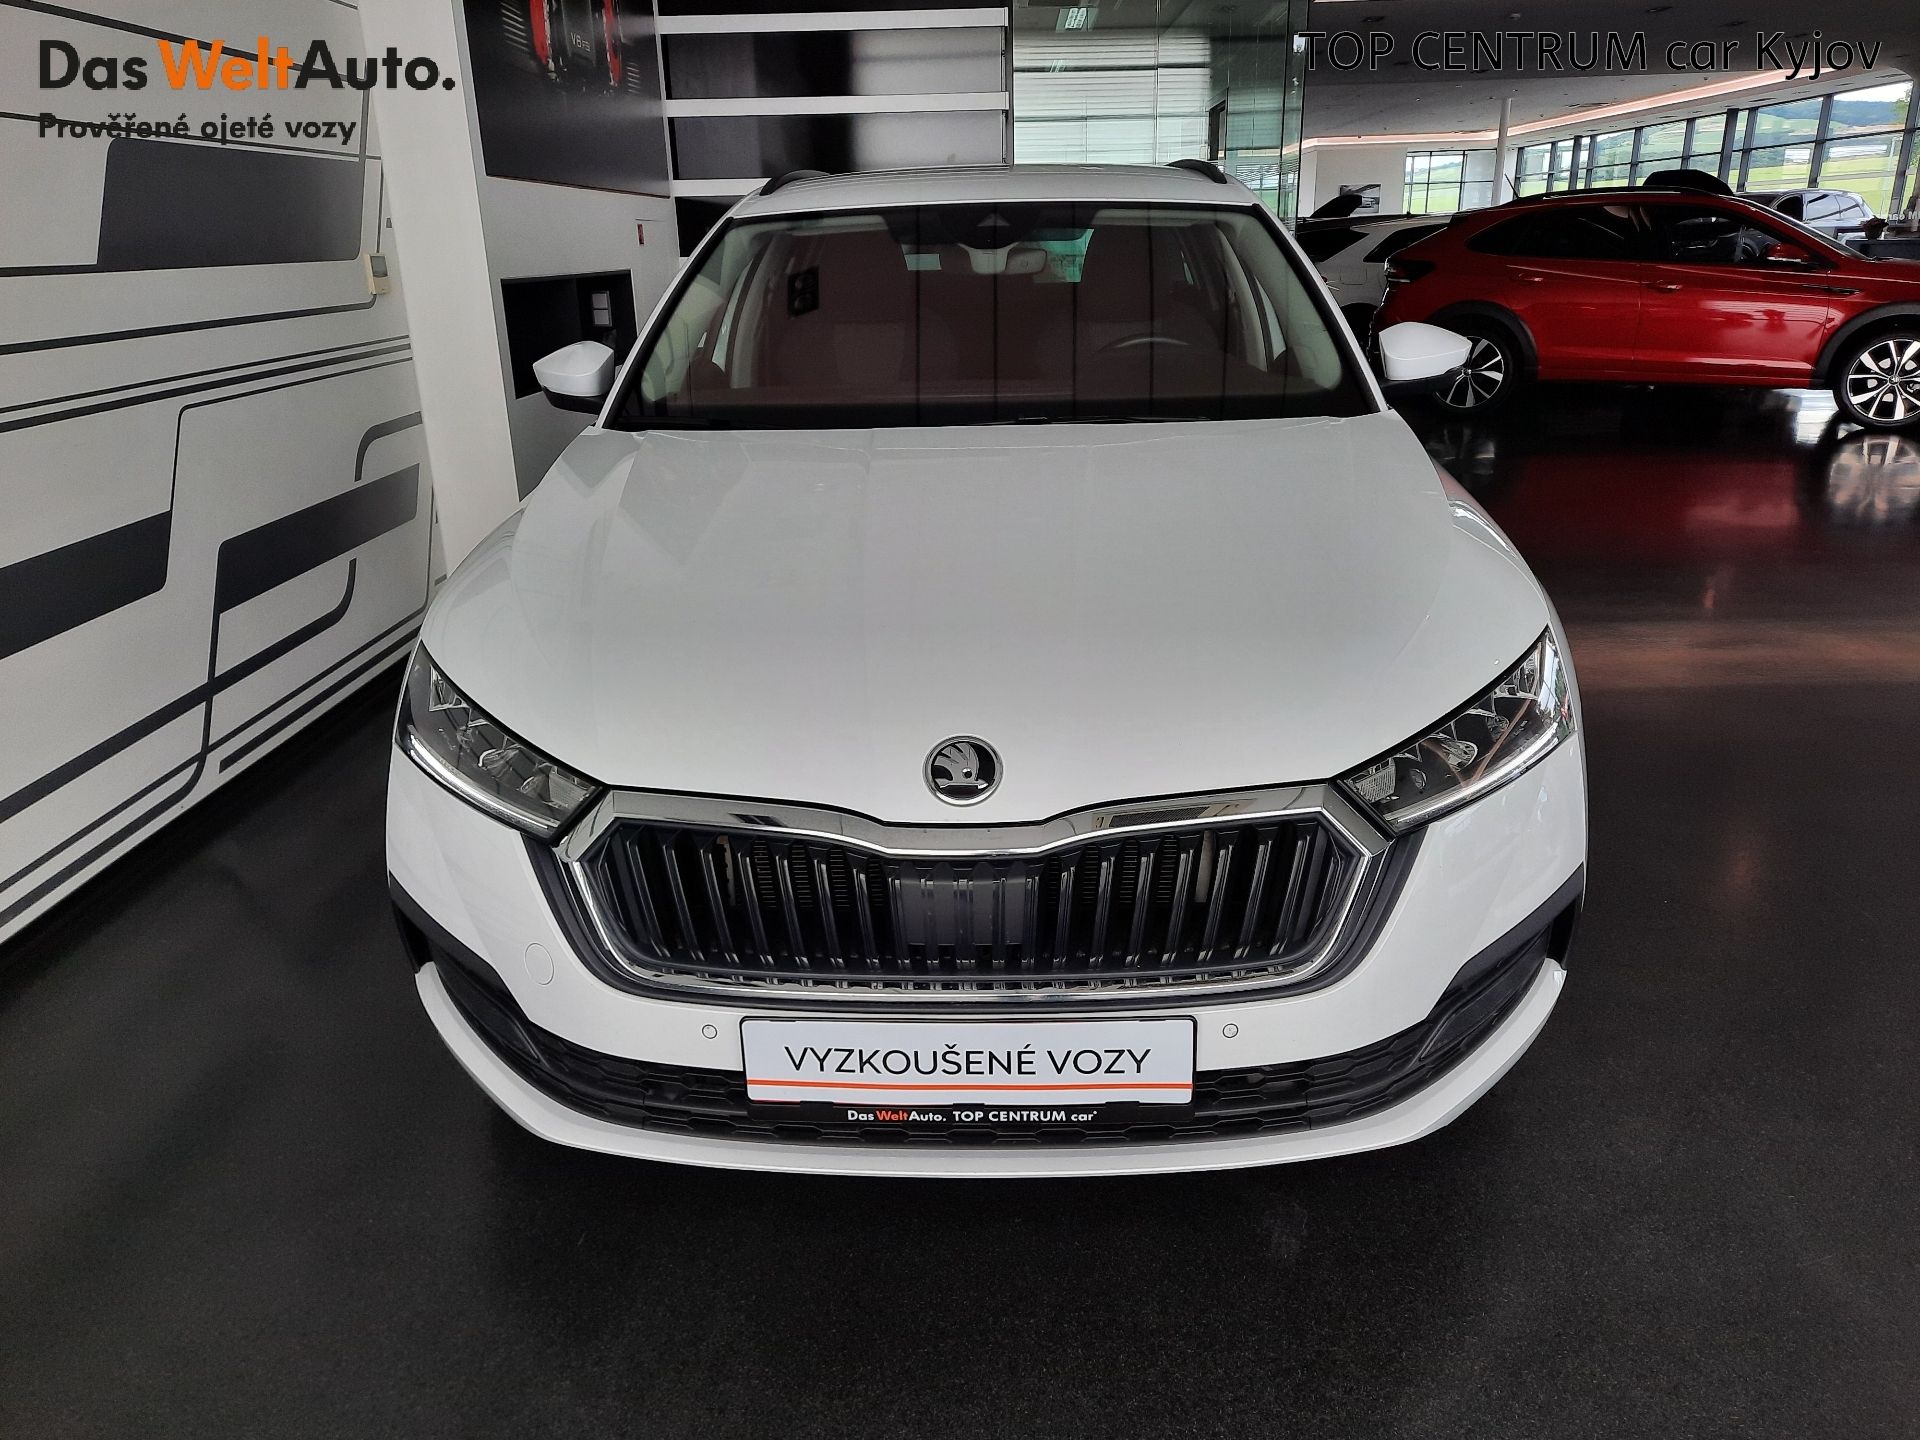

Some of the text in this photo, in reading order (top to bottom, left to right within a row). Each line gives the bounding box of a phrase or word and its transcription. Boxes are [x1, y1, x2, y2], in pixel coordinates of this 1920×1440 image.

[784, 1043, 1152, 1076] VYZKOUŠENÉ VOZY
[847, 1109, 875, 1122] Das
[952, 1110, 984, 1122] TOP
[988, 1110, 1067, 1122] CENTRUM
